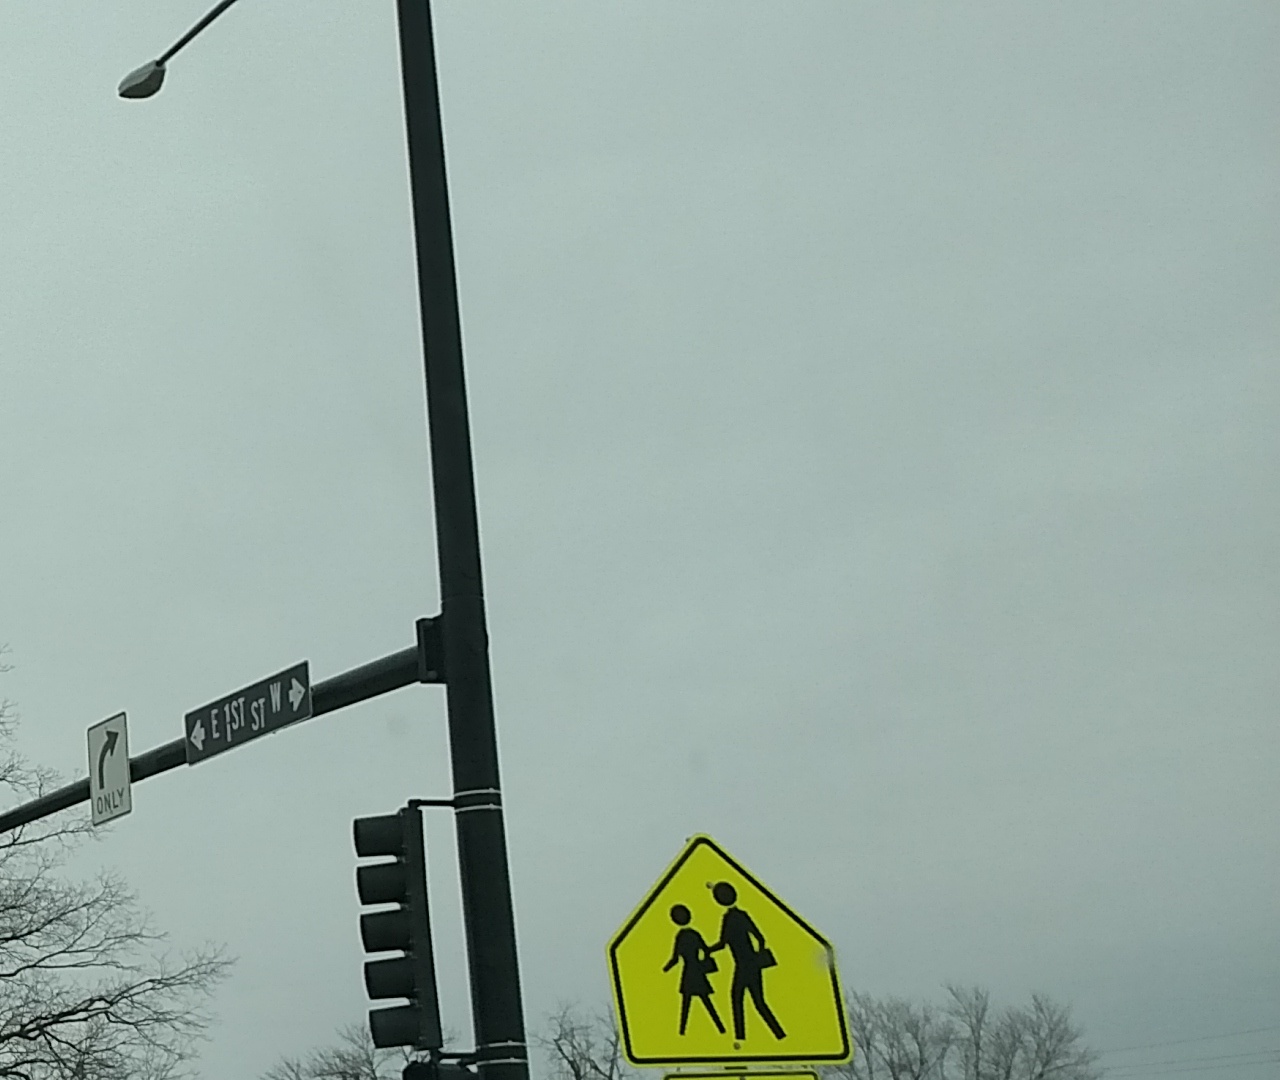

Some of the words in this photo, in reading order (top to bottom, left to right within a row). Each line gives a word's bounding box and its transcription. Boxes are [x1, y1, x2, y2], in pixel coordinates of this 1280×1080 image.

[210, 708, 220, 739] E
[223, 697, 245, 743] 1ST
[250, 697, 266, 731] ST
[269, 681, 281, 714] W
[96, 787, 124, 815] ONLY
